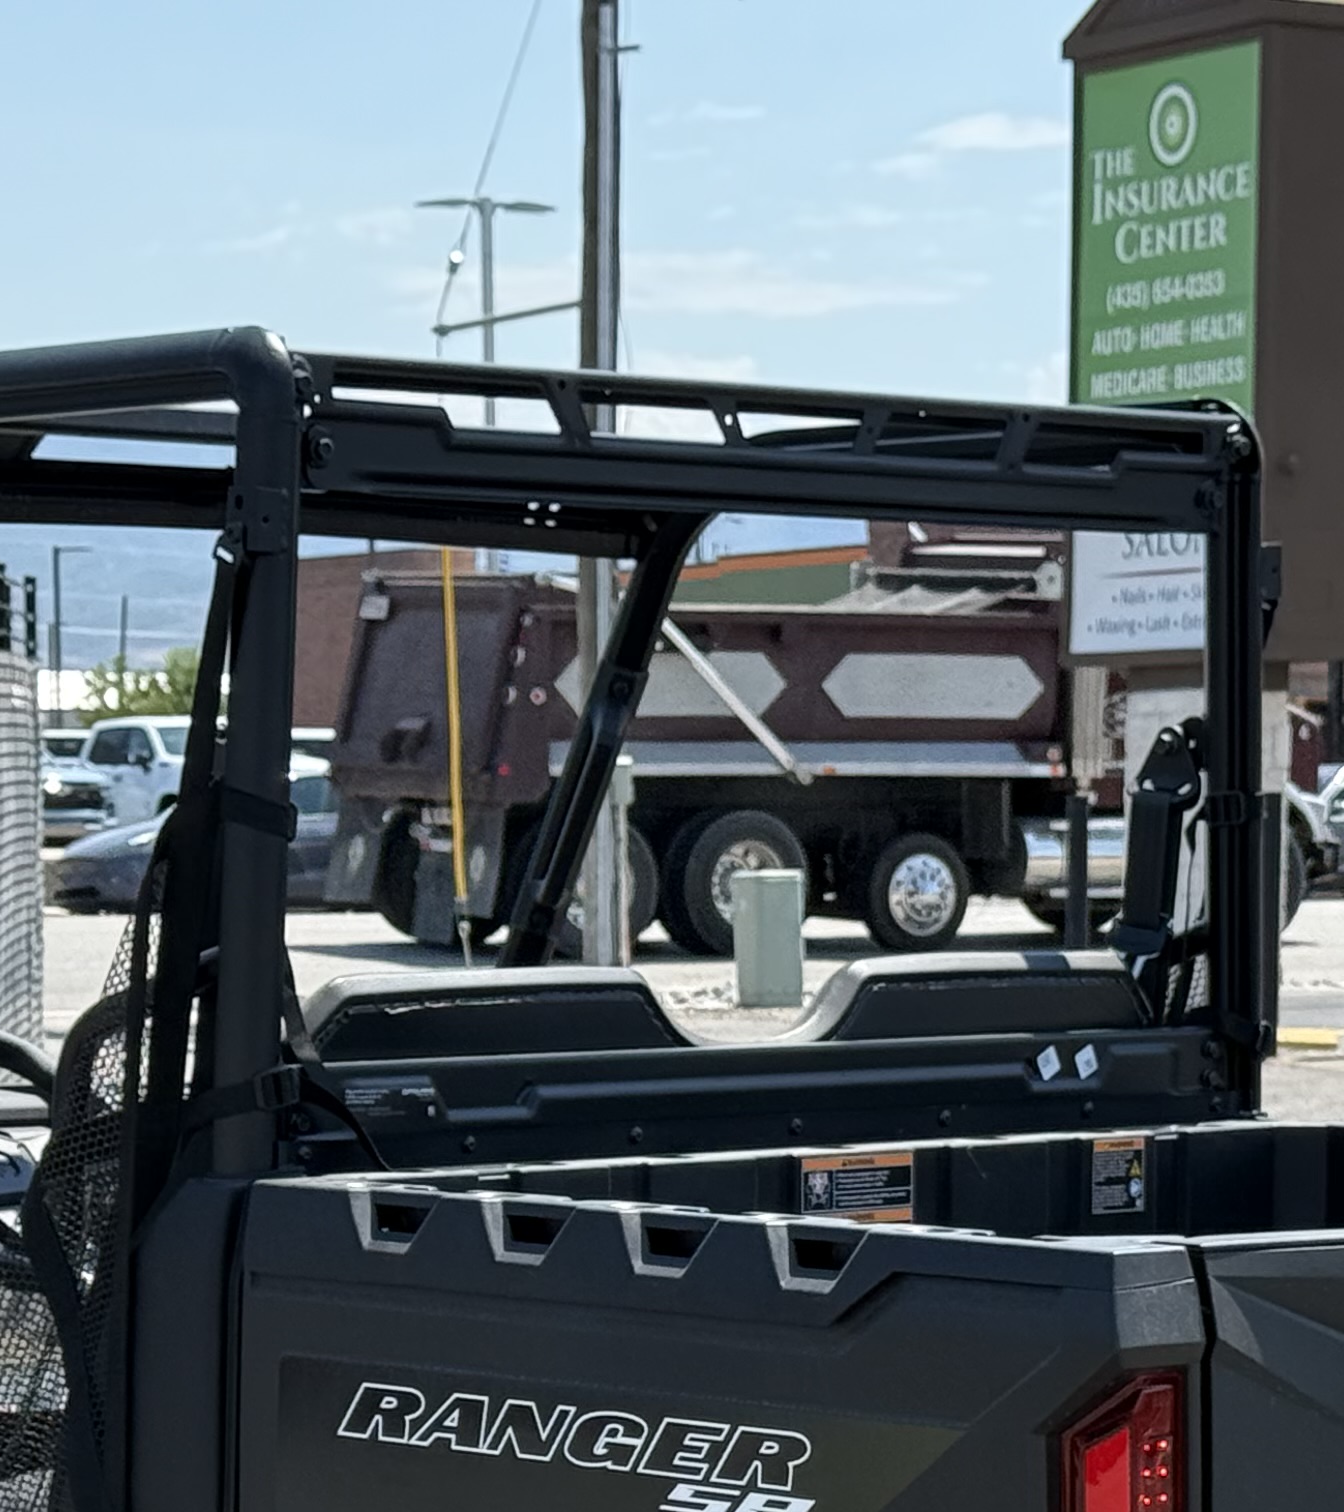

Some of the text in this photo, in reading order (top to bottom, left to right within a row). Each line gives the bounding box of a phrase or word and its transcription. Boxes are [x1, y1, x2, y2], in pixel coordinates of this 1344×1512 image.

[1090, 145, 1135, 181] THE
[1106, 279, 1150, 315] (435)
[1189, 310, 1246, 344] HEALTH
[1089, 353, 1247, 399] MEDICARE BUSINESS
[337, 1382, 812, 1492] RANGER
